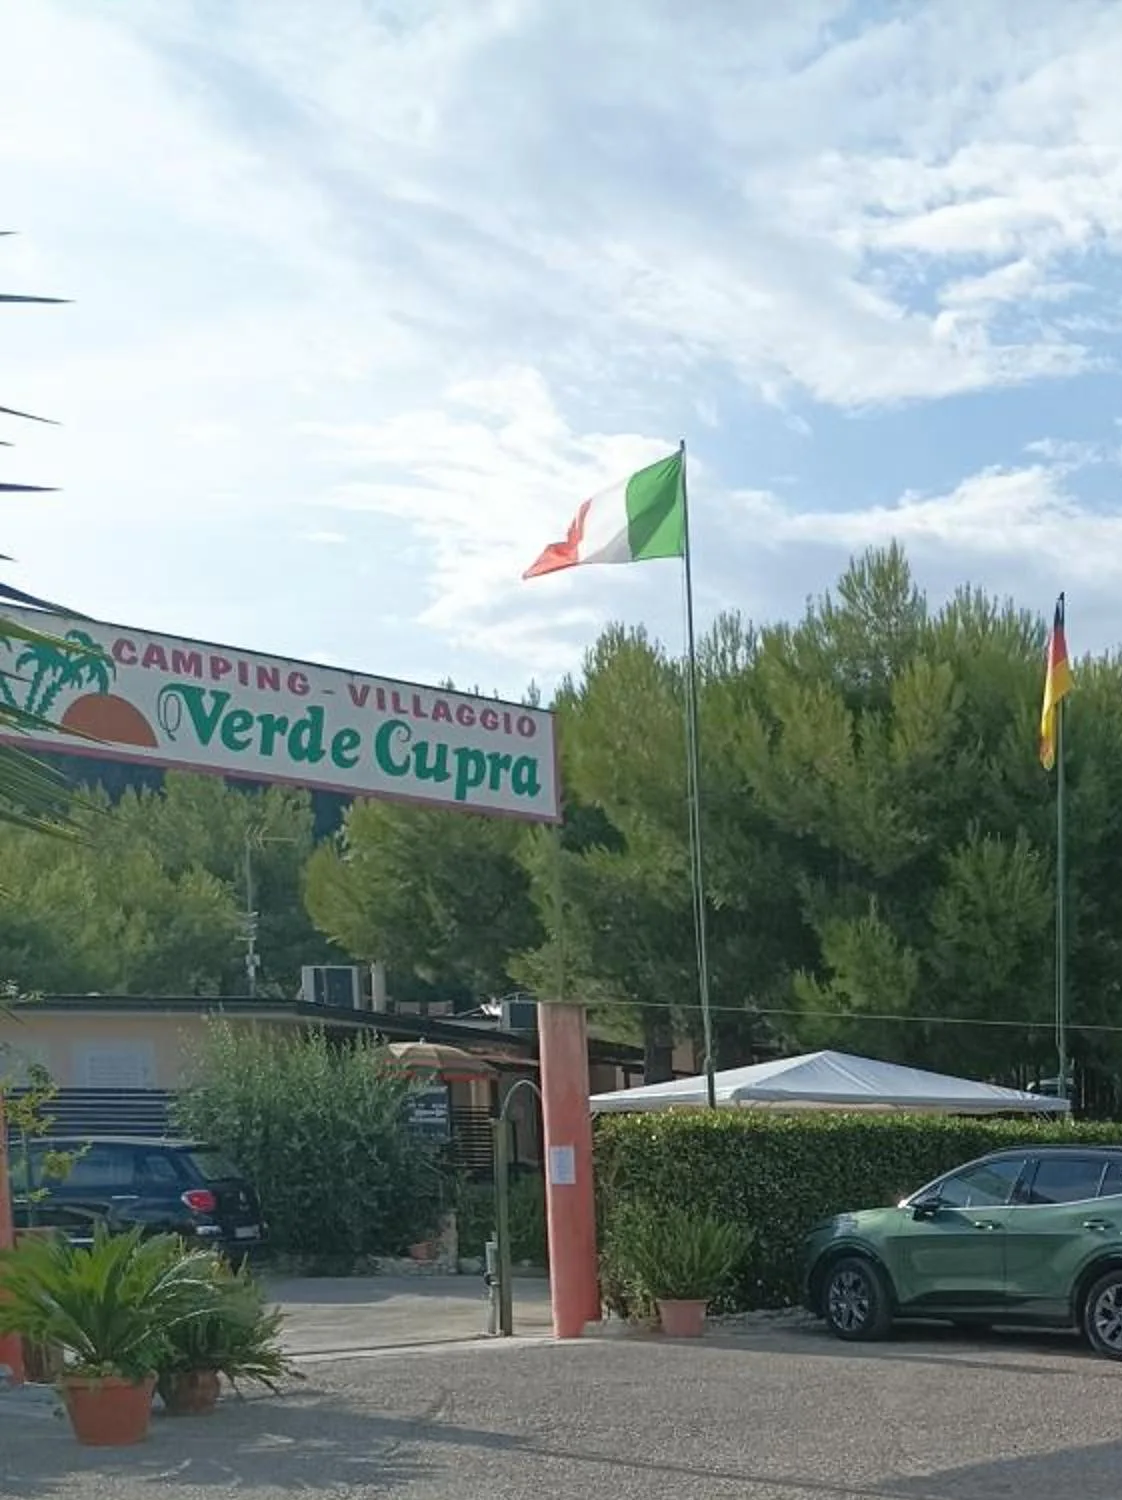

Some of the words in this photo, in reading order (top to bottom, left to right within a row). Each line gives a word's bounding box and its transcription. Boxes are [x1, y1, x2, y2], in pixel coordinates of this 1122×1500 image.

[112, 638, 311, 696] CAMPING
[348, 683, 537, 738] VILLAGGIO
[157, 682, 361, 769] Verde
[374, 719, 542, 801] Cupra
